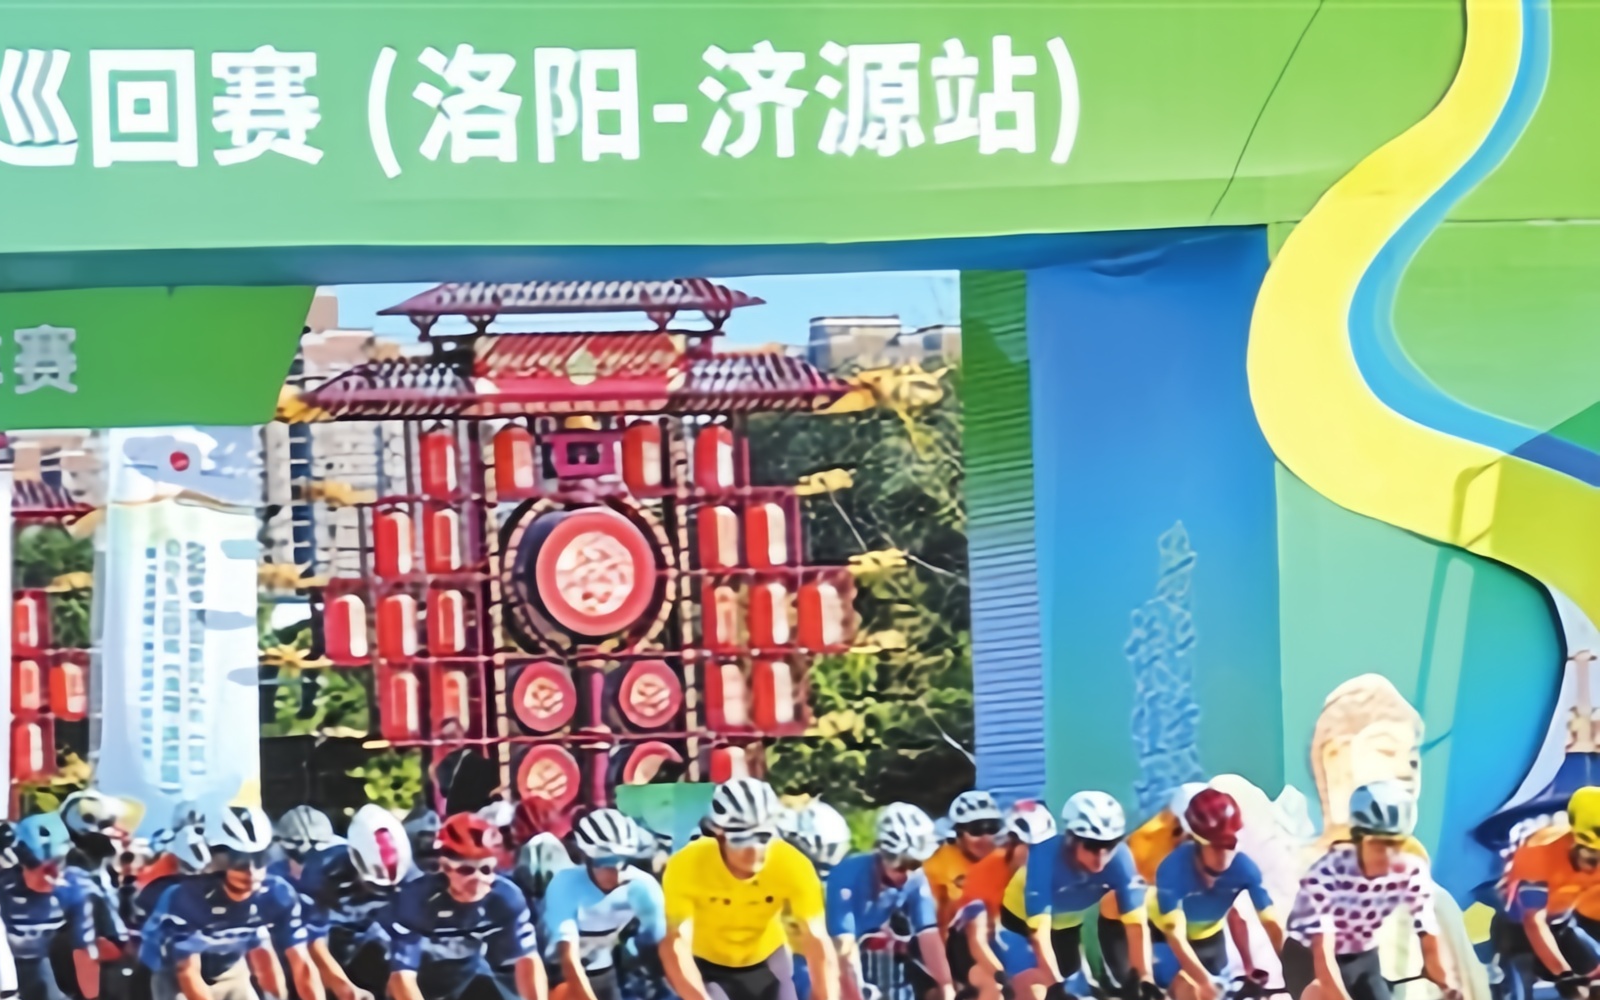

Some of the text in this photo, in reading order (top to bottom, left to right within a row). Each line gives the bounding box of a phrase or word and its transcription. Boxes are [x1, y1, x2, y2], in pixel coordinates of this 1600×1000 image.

[367, 34, 1081, 178] (洛阳-济源站)
